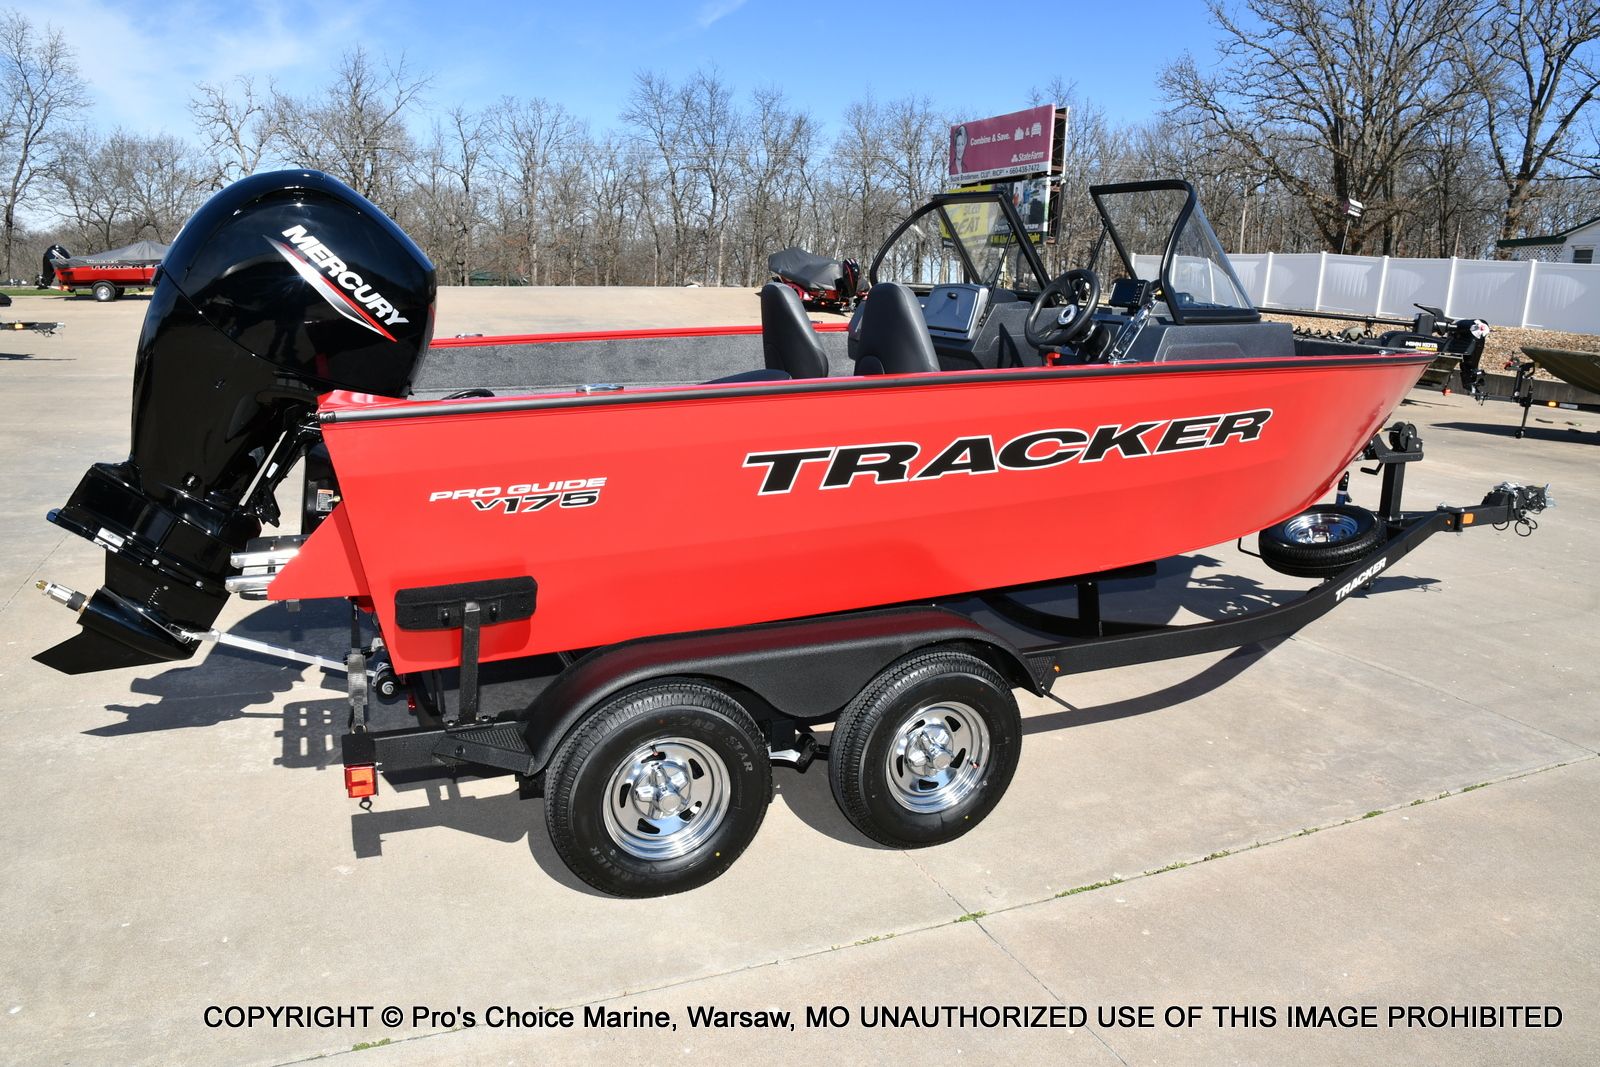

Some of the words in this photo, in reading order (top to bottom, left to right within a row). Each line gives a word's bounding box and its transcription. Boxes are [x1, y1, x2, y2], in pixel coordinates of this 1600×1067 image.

[970, 136, 991, 146] Combine
[992, 133, 996, 142] &
[281, 224, 409, 325] MERCURY
[741, 407, 1274, 496] TRACKER
[429, 487, 502, 502] PRO
[507, 476, 608, 495] GUIDE
[471, 488, 601, 514] V175
[1335, 556, 1387, 602] TRACKER
